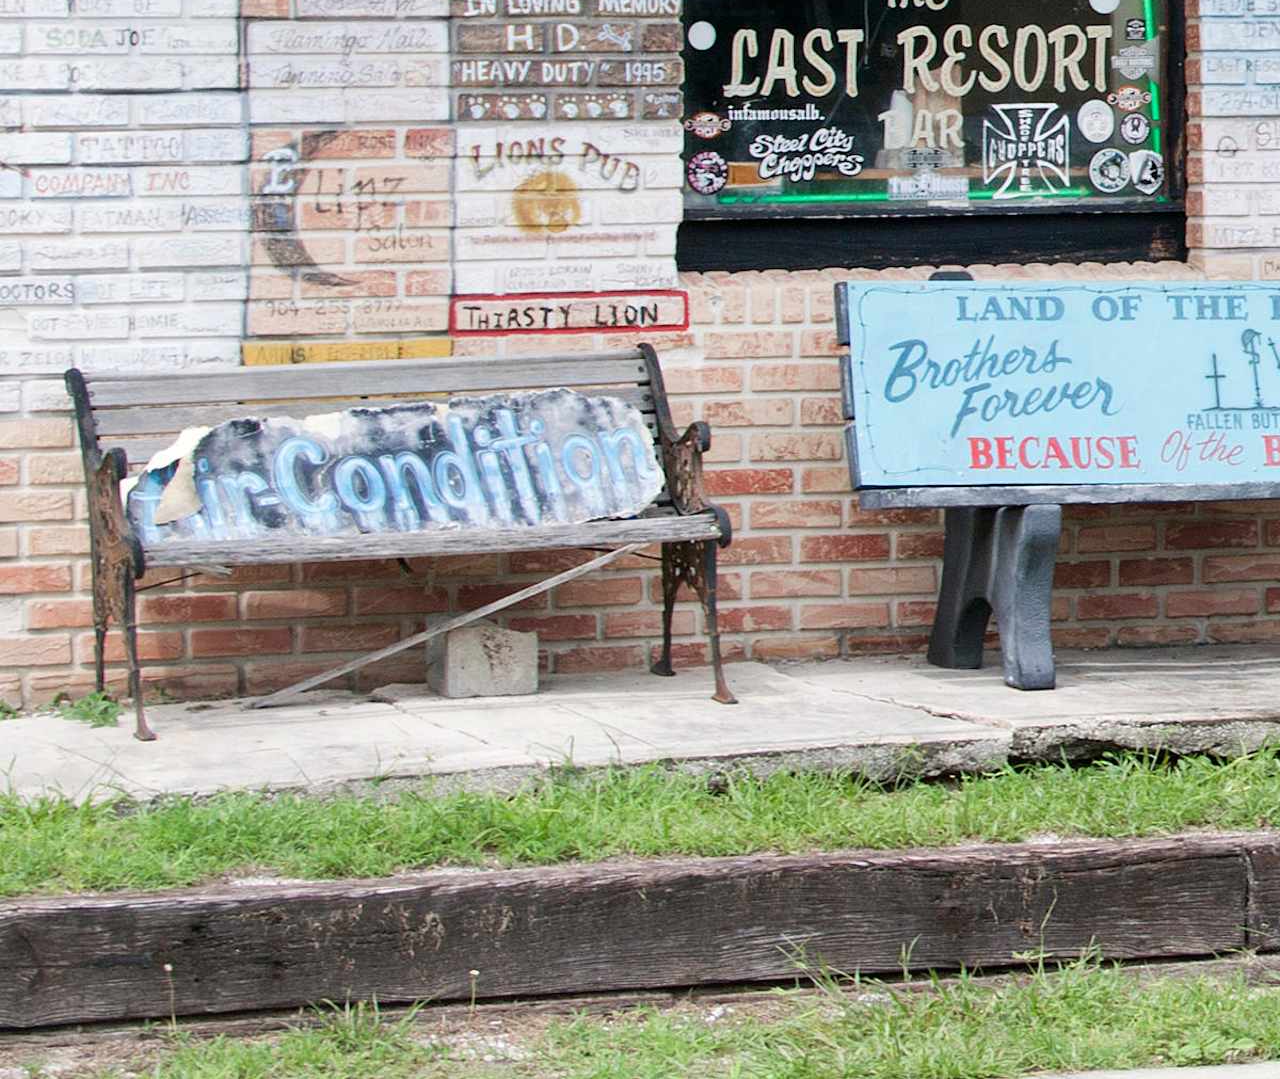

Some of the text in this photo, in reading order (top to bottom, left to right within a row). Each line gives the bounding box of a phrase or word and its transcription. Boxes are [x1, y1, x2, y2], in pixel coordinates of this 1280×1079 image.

[625, 62, 667, 83] 1995
[723, 28, 865, 98] LAST
[897, 24, 1113, 96] RESORT
[750, 126, 855, 158] Steel City
[989, 134, 1065, 168] CHOPPERS
[471, 136, 641, 194] LIONS PUB
[759, 153, 865, 182] Choppers
[463, 305, 573, 330] THIRSTY
[595, 303, 659, 327] LION
[956, 294, 1066, 322] LAND
[1091, 294, 1142, 322] OF
[1167, 294, 1249, 322] THE
[884, 334, 1073, 405] Brothers
[950, 380, 1123, 438] Forever
[1186, 411, 1244, 431] FALLEN
[967, 435, 1142, 471] BECAUSE
[1204, 434, 1246, 467] the
